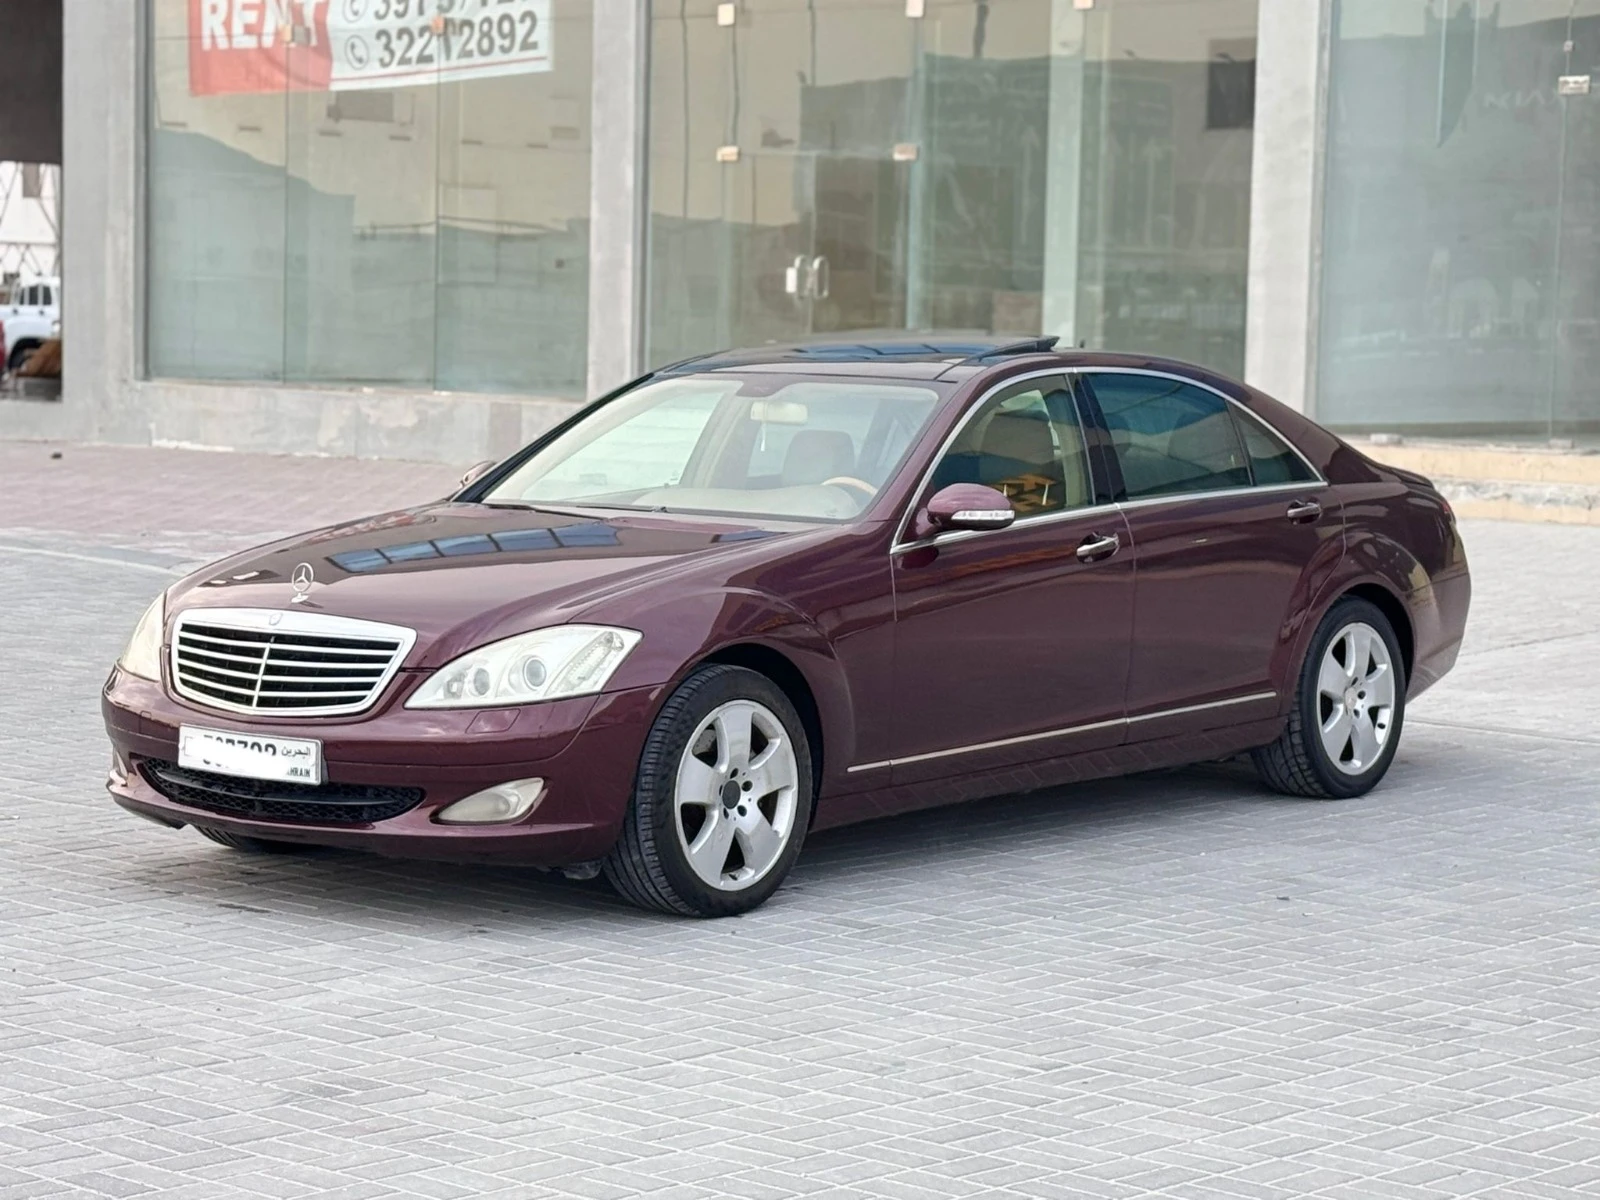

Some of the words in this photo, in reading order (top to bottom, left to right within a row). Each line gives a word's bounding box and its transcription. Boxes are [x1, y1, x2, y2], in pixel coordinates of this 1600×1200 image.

[201, 0, 328, 51] RENT
[281, 746, 311, 759] البحرين
[285, 767, 311, 778] HRAIN
